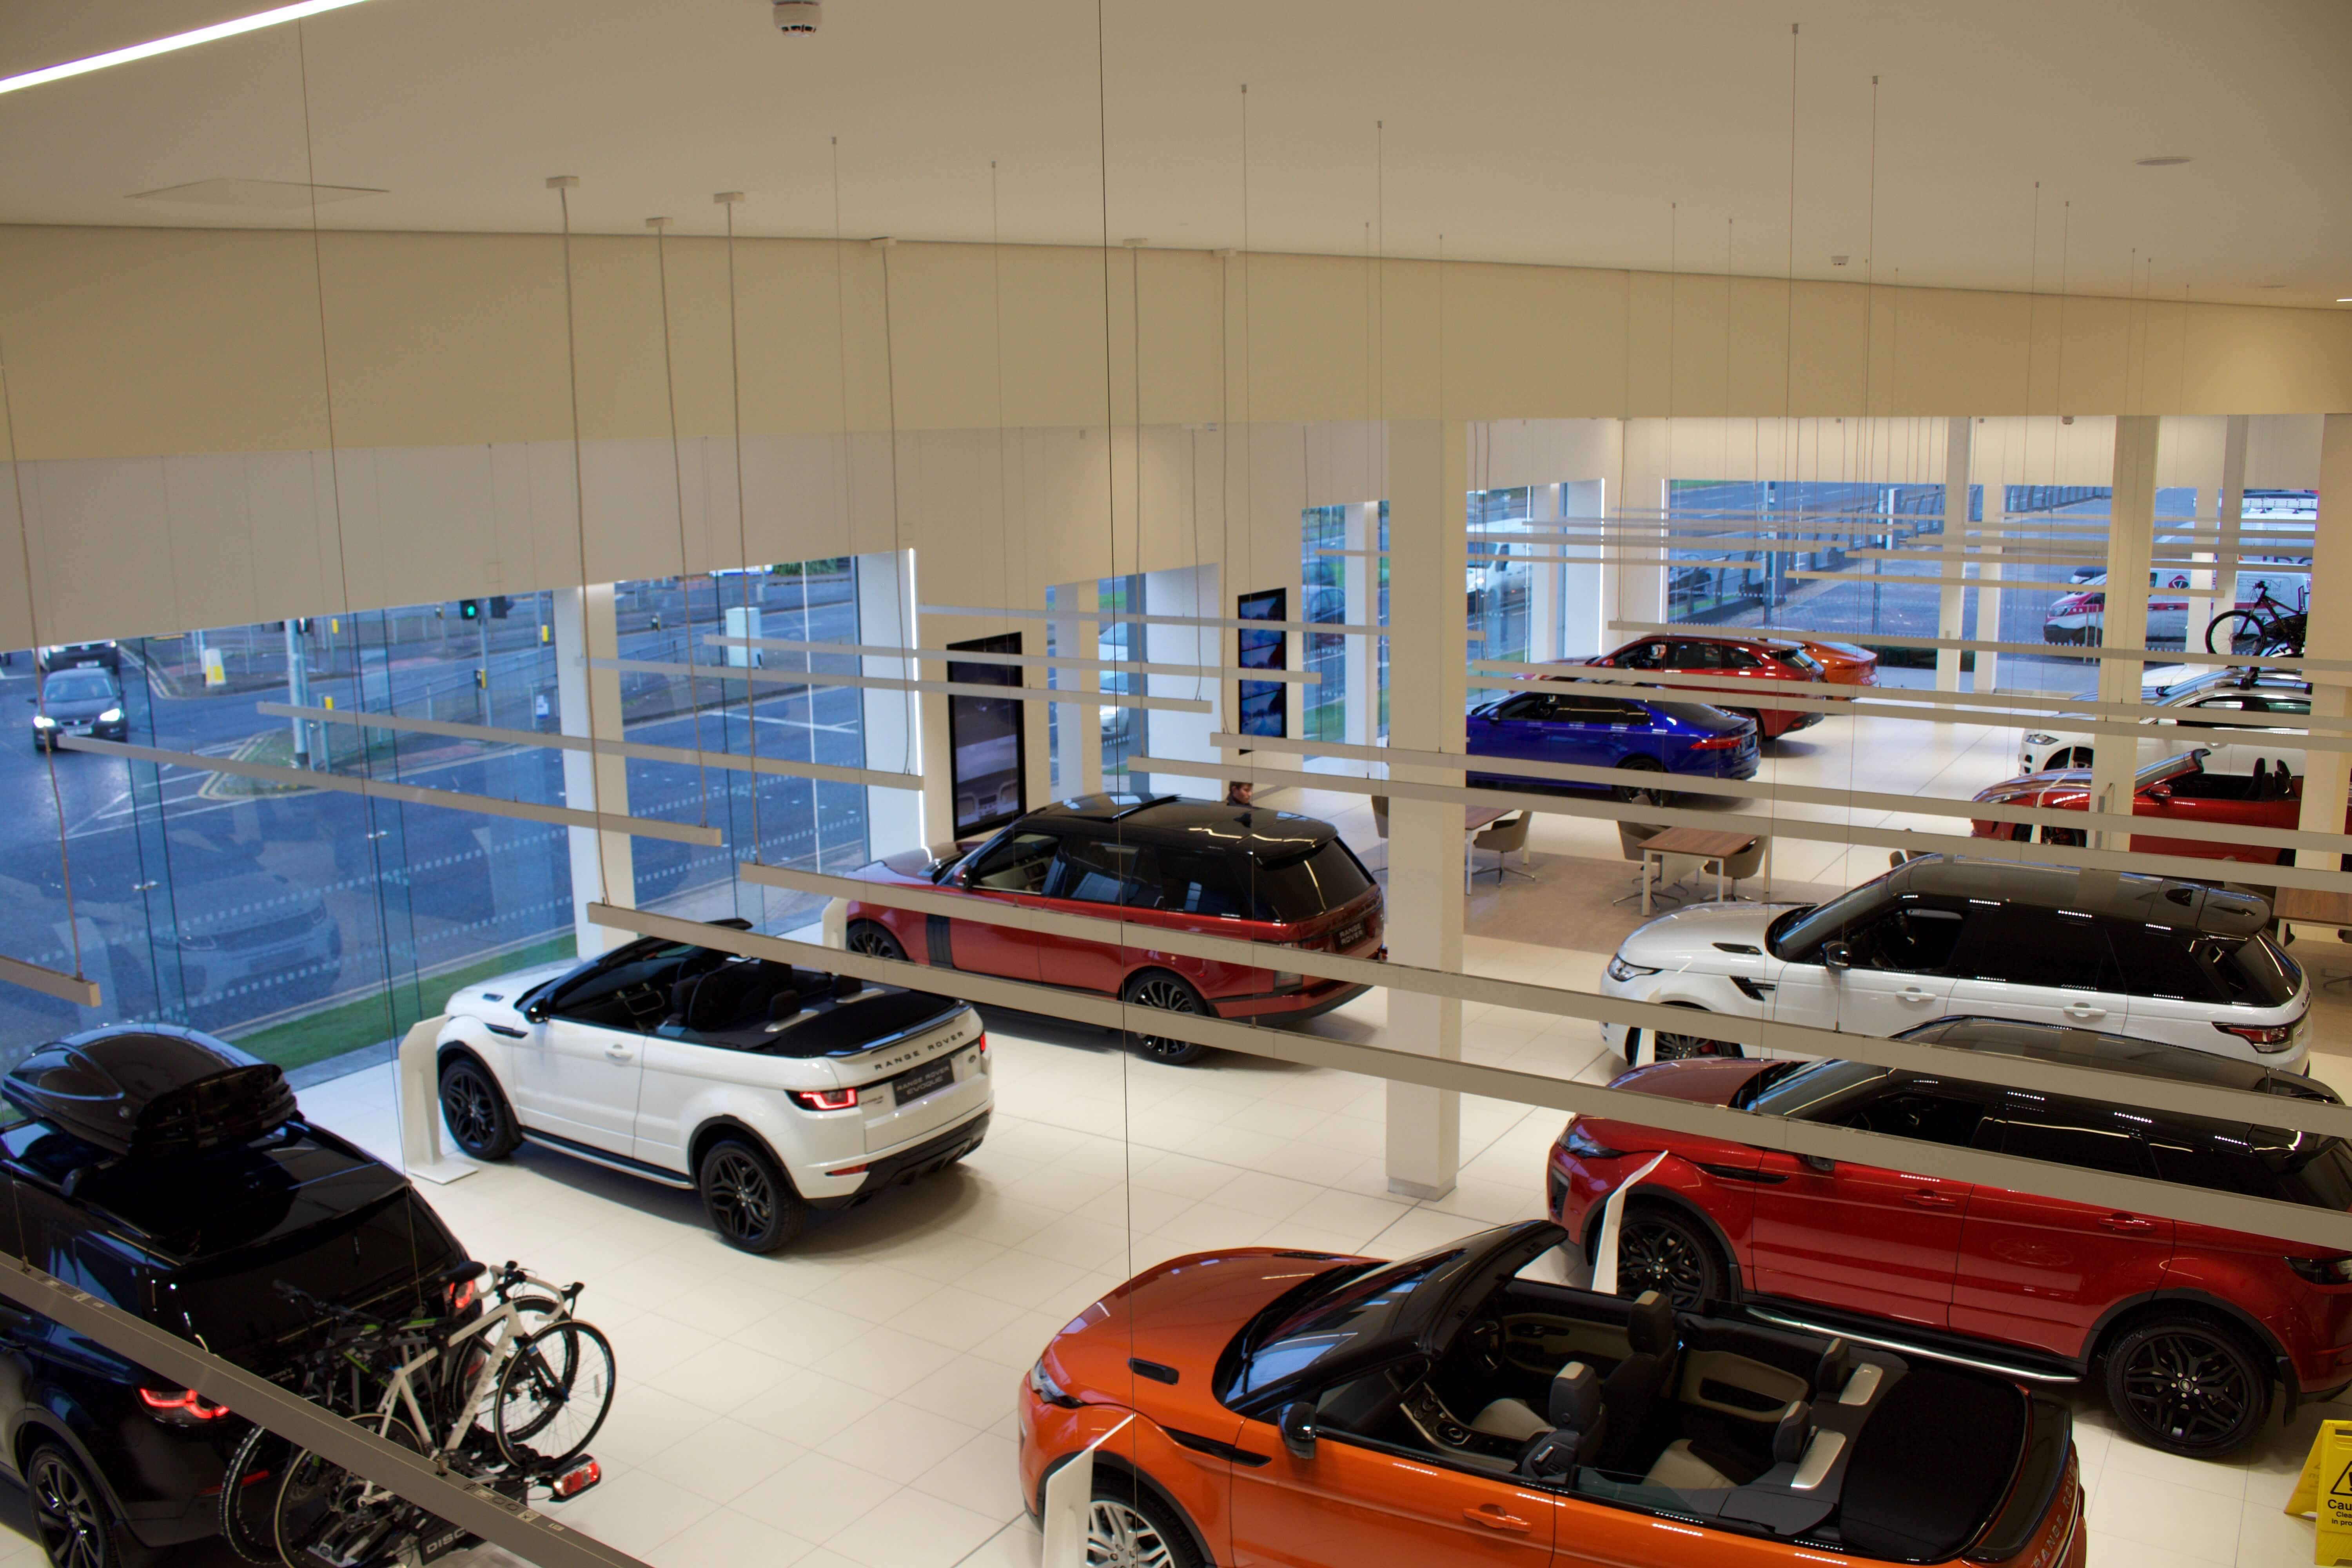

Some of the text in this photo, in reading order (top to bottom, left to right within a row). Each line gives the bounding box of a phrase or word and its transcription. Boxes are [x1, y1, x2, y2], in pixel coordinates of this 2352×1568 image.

[1339, 922, 1362, 938] RANGE
[1341, 929, 1364, 946] ROVER
[874, 1031, 964, 1071] RANGE ROVER
[897, 1065, 949, 1092] RANGE ROVER
[906, 1076, 943, 1095] EVOQUE
[2032, 1455, 2077, 1568] RANGE ROVER
